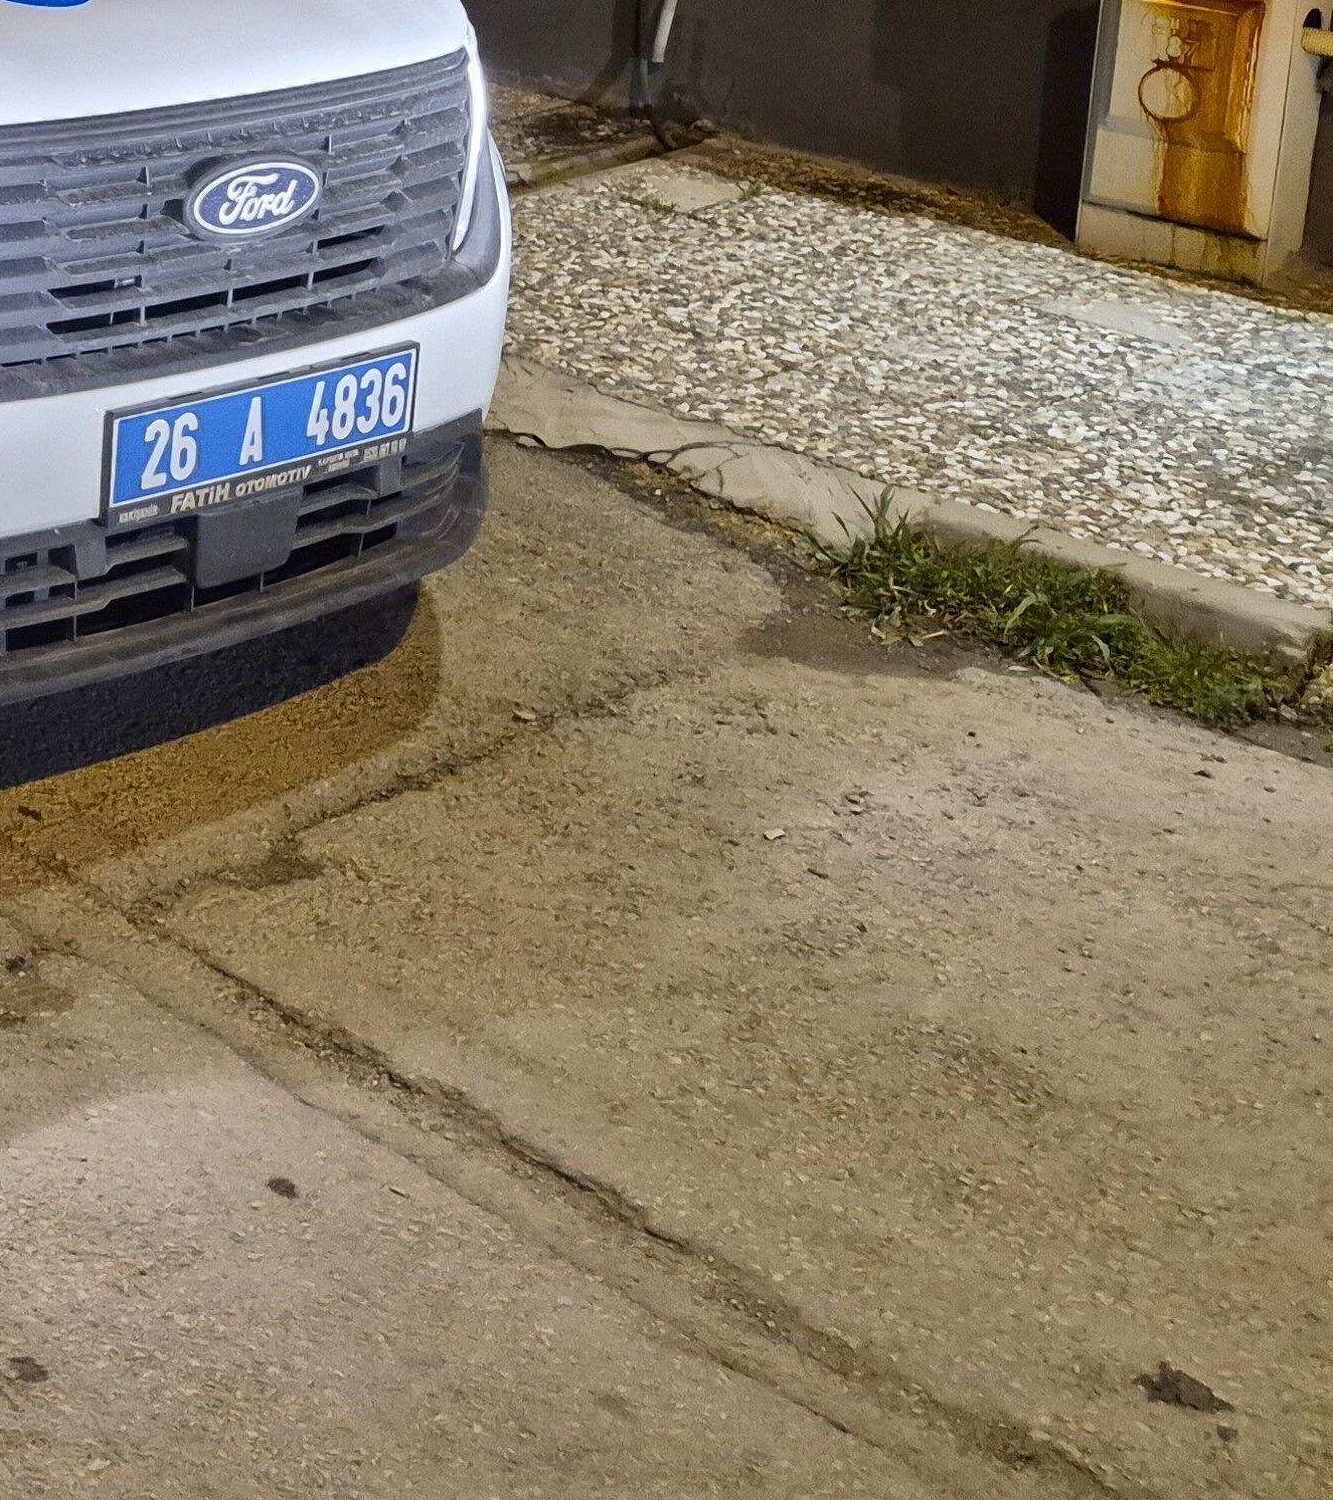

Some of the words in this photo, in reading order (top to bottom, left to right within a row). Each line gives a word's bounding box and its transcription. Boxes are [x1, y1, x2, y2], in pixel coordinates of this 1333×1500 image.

[219, 173, 297, 222] Ford
[141, 412, 199, 490] 26
[239, 396, 263, 465] A
[306, 362, 407, 446] 4836
